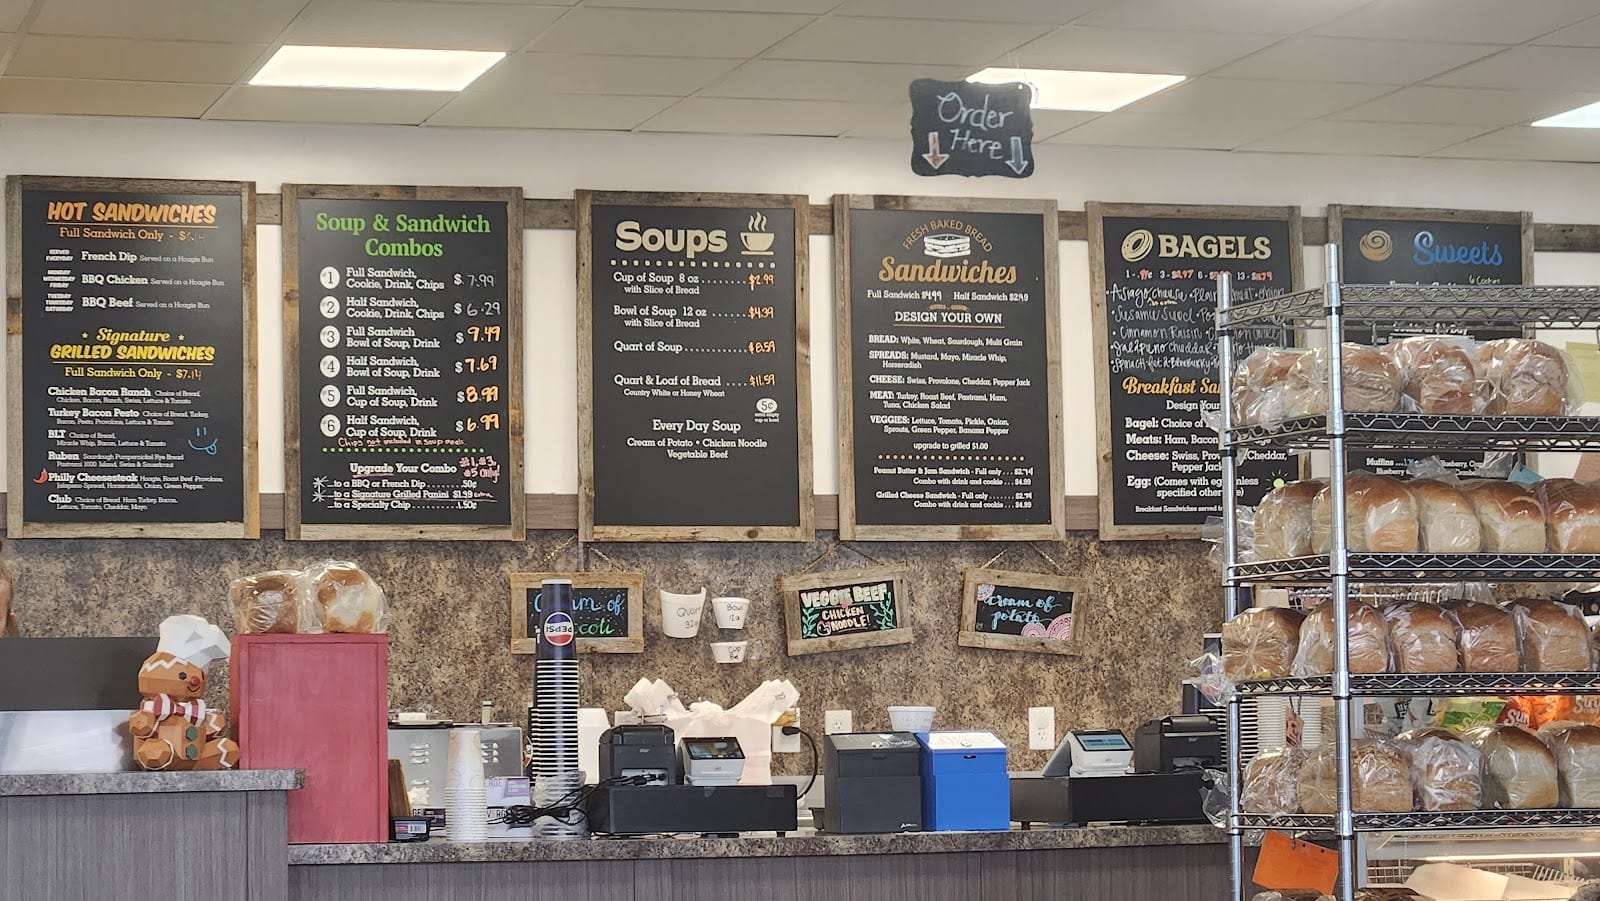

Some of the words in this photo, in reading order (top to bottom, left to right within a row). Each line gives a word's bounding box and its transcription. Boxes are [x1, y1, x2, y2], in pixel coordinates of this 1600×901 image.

[937, 92, 1014, 130] Order
[950, 129, 1003, 159] Here
[47, 202, 87, 221] HOT
[92, 204, 217, 224] SANDWICHES
[316, 213, 365, 235] Soup
[373, 214, 389, 232] &
[396, 214, 491, 233] Sandwich
[615, 221, 728, 258] Soups
[903, 224, 929, 250] FRESH
[930, 220, 963, 231] BAKED
[965, 224, 992, 252] BREAD
[365, 238, 443, 256] Combos
[1158, 234, 1271, 259] BAGELS
[1413, 230, 1503, 265] Sweets
[81, 251, 117, 261] French
[119, 252, 137, 263] Dip
[346, 268, 365, 277] Full
[367, 269, 417, 278] Sandwich,
[879, 256, 1017, 284] Sandwiches
[81, 275, 104, 285] BBQ
[107, 275, 148, 285] Chicken
[613, 272, 634, 284] Cup
[637, 272, 646, 282] of
[649, 273, 674, 285] Soup
[679, 274, 685, 282] 8
[346, 279, 382, 289] Cookie,
[385, 280, 413, 289] Drink,
[416, 280, 444, 291] Chips
[867, 290, 881, 298] Full
[883, 291, 919, 299] Sandwich
[922, 291, 942, 301] $4.99
[954, 292, 970, 300] Half
[972, 293, 1007, 301] Sandwich
[82, 298, 105, 308] BBQ
[109, 298, 134, 308] Beef
[326, 301, 335, 314] 2
[346, 297, 368, 306] Half
[370, 298, 419, 307] Sandwich,
[613, 305, 637, 316] Bowl
[640, 306, 649, 316] of
[651, 306, 676, 318] Soup
[682, 307, 693, 316] 12
[895, 311, 937, 322] DESIGN
[941, 313, 972, 323] YOUR
[975, 313, 1002, 324] OWN
[97, 328, 171, 345] Signature
[326, 331, 335, 343] 3
[467, 325, 501, 342] 9.49
[346, 338, 369, 347] Bowl
[372, 338, 382, 347] of
[383, 339, 410, 349] Soup,
[413, 339, 440, 348] Drink
[869, 335, 899, 343] BREAD:
[923, 337, 946, 345] Wheat,
[947, 337, 984, 346] Sourdough,
[986, 338, 1002, 346] Multi
[50, 344, 112, 359] GRILLED
[117, 346, 216, 361] SANDWICHES
[614, 341, 643, 352] Quart
[645, 341, 655, 351] of
[657, 342, 682, 353] Soup
[346, 356, 368, 365] Half
[370, 357, 419, 366] Sandwich,
[869, 351, 909, 359] SPREADS:
[326, 360, 335, 373] 4
[65, 367, 85, 377] Full
[87, 368, 136, 377] Sandwich
[138, 368, 163, 380] Only
[869, 375, 905, 384] CHEESE:
[614, 375, 643, 386] Quart
[646, 376, 653, 385] &
[656, 376, 677, 385] Loaf
[680, 376, 690, 386] of
[692, 376, 721, 386] Bread
[1122, 377, 1196, 396] Breakfast
[48, 387, 87, 397] Chicken
[89, 388, 119, 397] Bacon
[120, 388, 151, 397] Ranch
[327, 390, 335, 402] 5
[624, 389, 650, 397] Country
[681, 389, 702, 398] Honey
[869, 391, 894, 399] MEAT:
[1166, 400, 1198, 411] Design
[48, 408, 80, 419] Turkey
[82, 408, 112, 418] Bacon
[114, 409, 139, 418] Pesto
[327, 419, 335, 431] 6
[467, 413, 500, 431] 6.99
[870, 416, 910, 424] VEGGIES:
[1125, 417, 1159, 429] Bagel:
[1161, 419, 1193, 428] Choice
[653, 420, 683, 433] Every
[686, 420, 709, 433] Day
[712, 421, 741, 433] Soup
[48, 430, 66, 439] BLT
[1126, 434, 1162, 444] Meats:
[1165, 435, 1188, 445] Ham,
[627, 439, 656, 447] Cream
[657, 439, 666, 447] of
[667, 439, 693, 447] Potato
[702, 439, 736, 448] Chicken
[738, 439, 767, 448] Noodle
[48, 452, 80, 460] Ruben
[667, 450, 708, 459] Vegetable
[710, 450, 728, 459] Beef
[1126, 450, 1169, 461] Cheese:
[1172, 452, 1199, 461] Swiss,
[1247, 452, 1287, 461] Cheddar,
[349, 463, 394, 474] Upgrade
[396, 464, 418, 473] Your
[420, 464, 457, 473] Combo
[1172, 462, 1203, 473] Pepper
[48, 473, 75, 484] Philly
[77, 473, 138, 482] Cheesesteak
[1127, 476, 1151, 488] Egg:
[1154, 477, 1188, 486] (Comes
[1190, 477, 1209, 486] with
[1156, 487, 1197, 498] specified
[48, 495, 72, 504] Club
[853, 583, 887, 602] BEEF
[607, 595, 624, 615] of
[987, 596, 1033, 608] cream
[822, 606, 864, 620] CHICKEN
[992, 610, 1040, 630] potato
[1504, 709, 1530, 726] Sun
